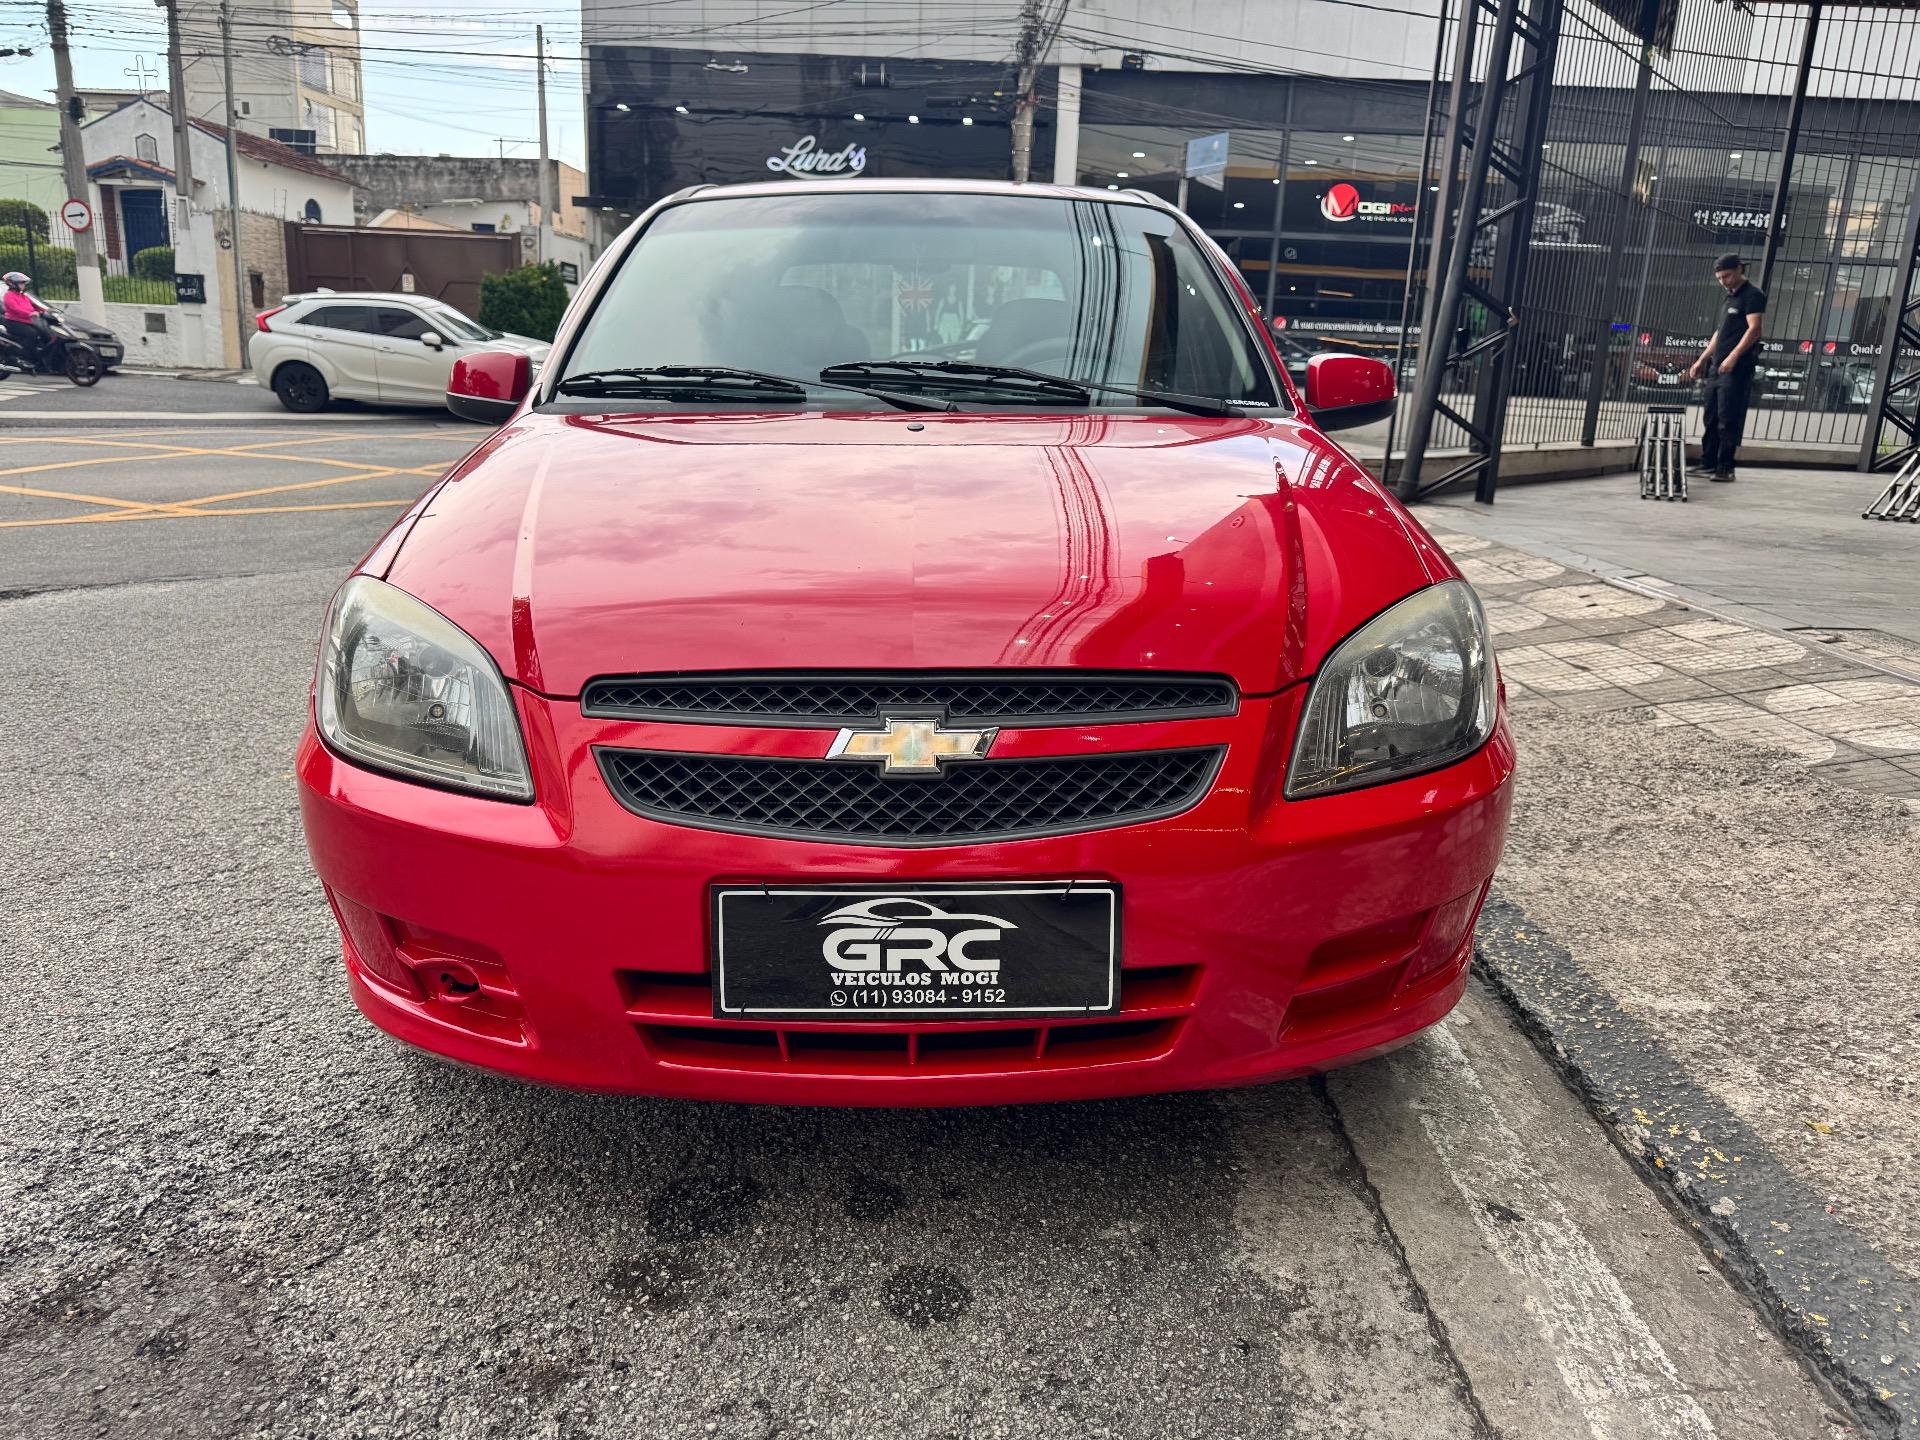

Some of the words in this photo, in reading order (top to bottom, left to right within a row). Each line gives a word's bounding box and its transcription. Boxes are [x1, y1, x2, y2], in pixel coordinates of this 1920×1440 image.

[822, 927, 1001, 971] GRC
[830, 971, 932, 986] VEICULOS
[940, 971, 999, 985] MOGI
[852, 989, 887, 1007] (11)
[892, 989, 947, 1004] 93084
[962, 988, 1006, 1004] 9152
